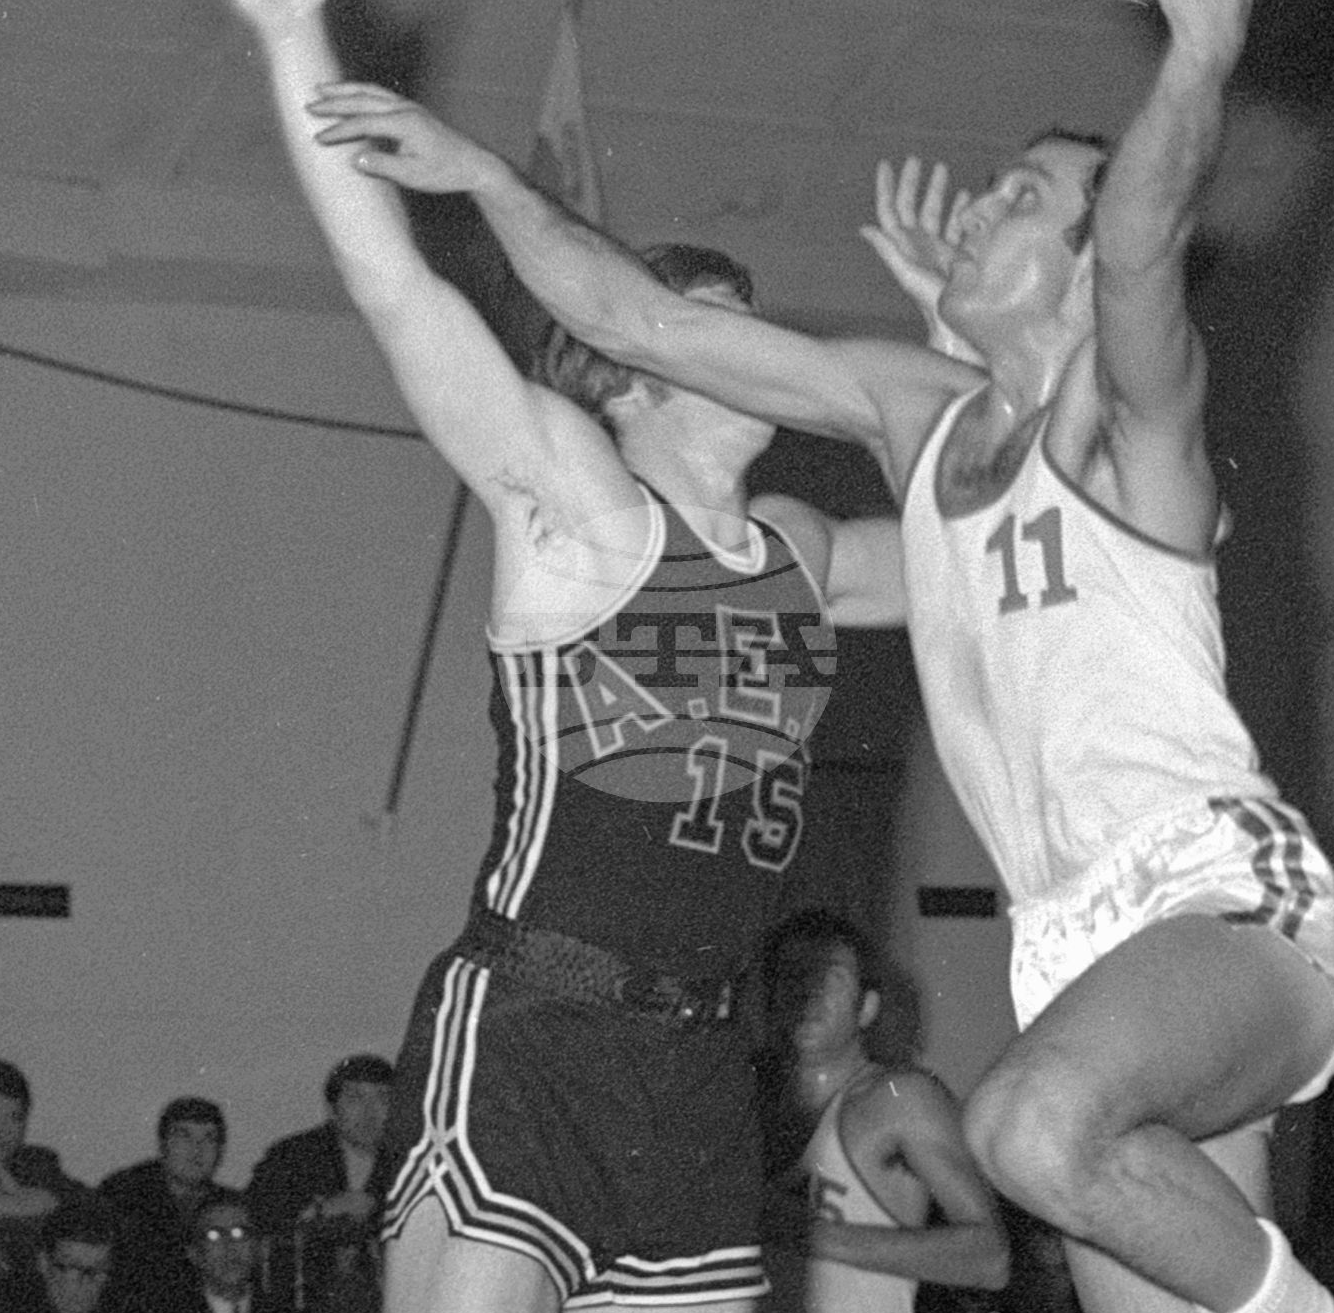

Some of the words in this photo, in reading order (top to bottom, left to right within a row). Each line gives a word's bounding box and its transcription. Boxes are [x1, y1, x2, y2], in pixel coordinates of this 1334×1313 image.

[985, 506, 1078, 615] 11
[563, 604, 814, 764] A.E.
[669, 735, 803, 872] 15
